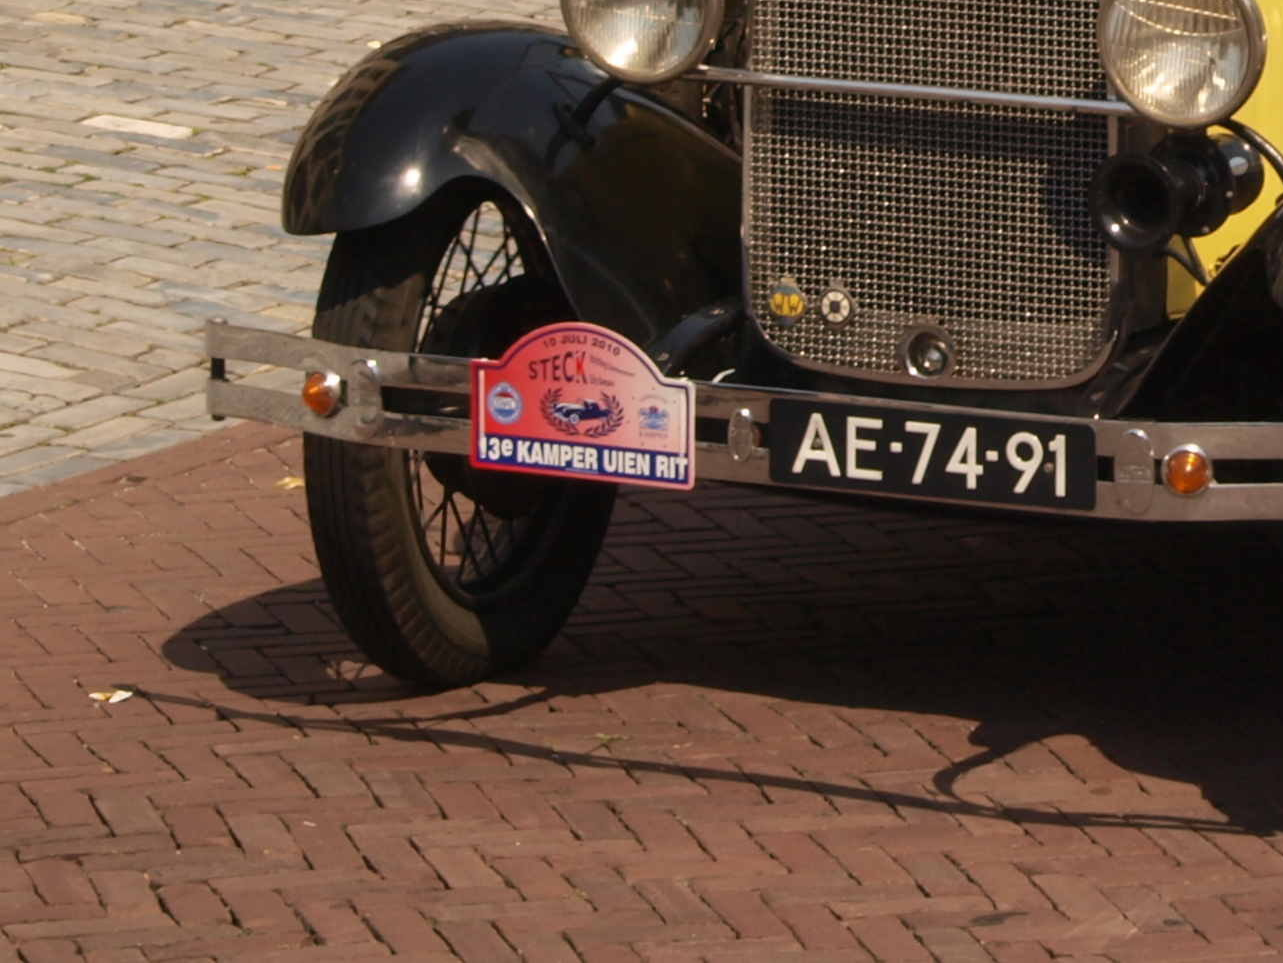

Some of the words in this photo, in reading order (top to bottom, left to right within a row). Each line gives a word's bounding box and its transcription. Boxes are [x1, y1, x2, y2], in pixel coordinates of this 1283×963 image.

[561, 335, 587, 344] JULI
[592, 338, 621, 356] 2010
[517, 440, 598, 470] KAMPER
[603, 449, 651, 475] UIEN
[655, 454, 688, 480] RIT
